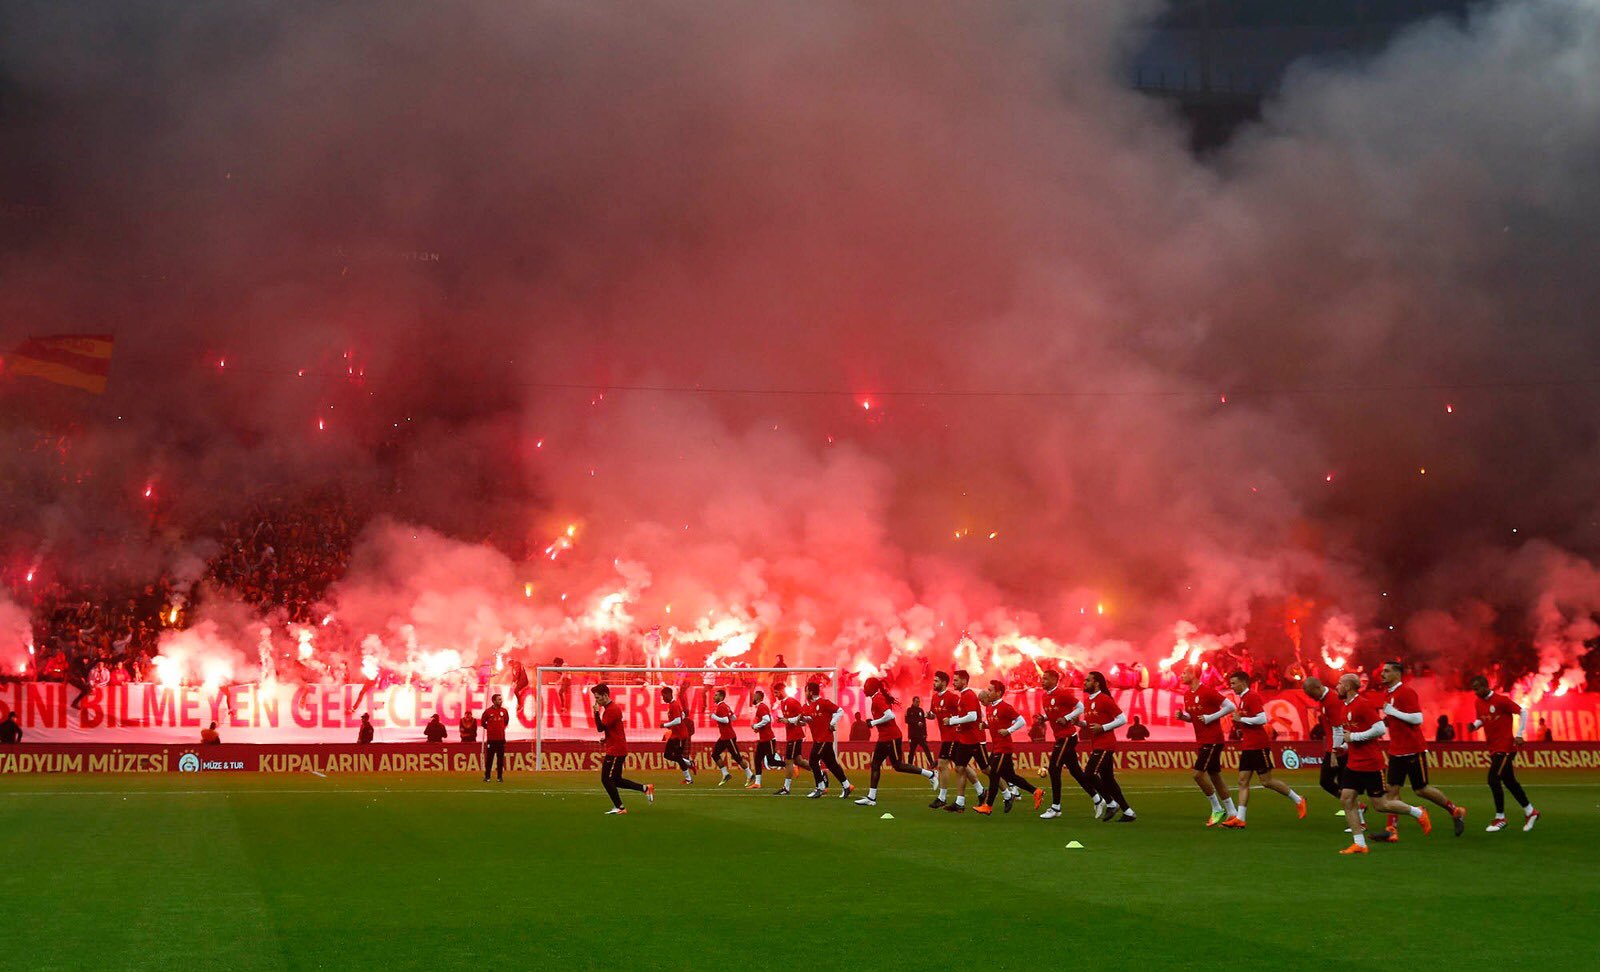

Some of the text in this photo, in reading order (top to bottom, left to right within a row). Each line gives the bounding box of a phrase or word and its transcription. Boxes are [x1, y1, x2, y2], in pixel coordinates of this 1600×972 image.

[88, 750, 168, 773] MÜZESİ
[203, 760, 244, 770] MÜZE & TUR
[258, 753, 374, 773] KUPALARIN
[378, 748, 450, 772] ADRESİ
[590, 751, 681, 771] SDYU
